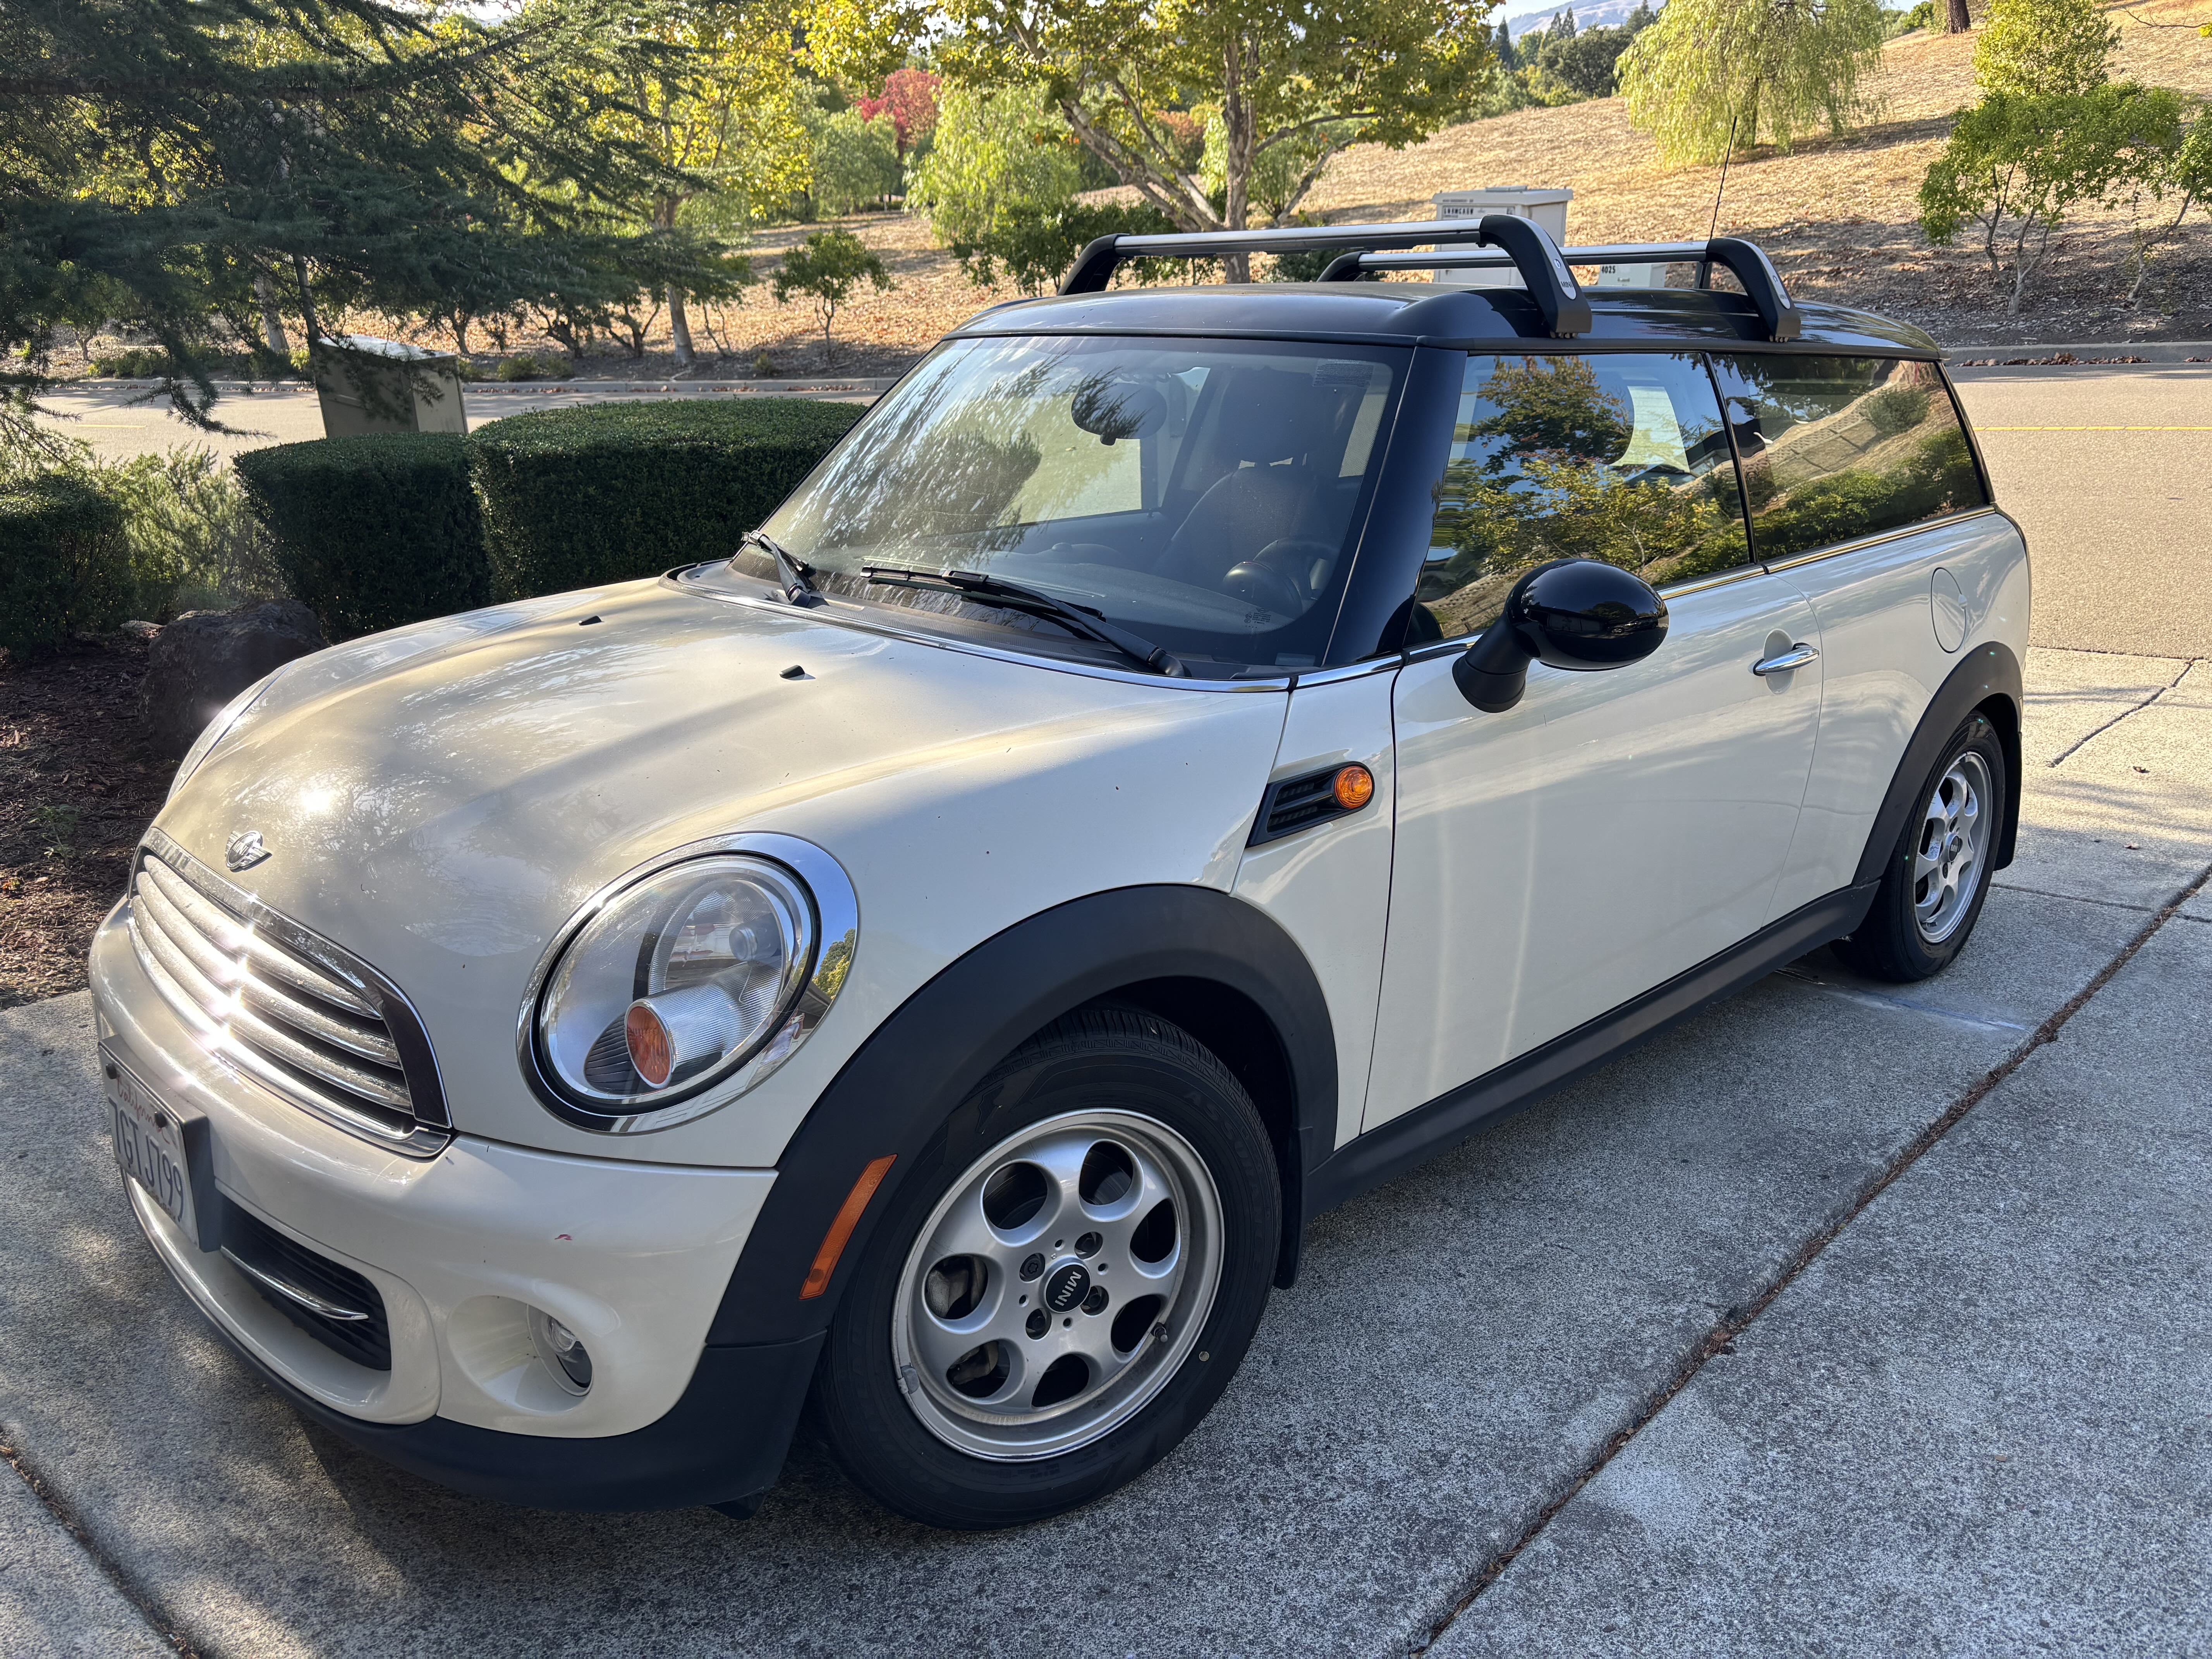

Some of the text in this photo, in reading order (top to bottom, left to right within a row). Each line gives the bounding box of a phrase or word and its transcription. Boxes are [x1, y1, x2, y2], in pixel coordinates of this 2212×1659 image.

[117, 1073, 170, 1144] Californa
[108, 1095, 184, 1219] 7GTJ799
[1054, 1271, 1082, 1307] MINI
